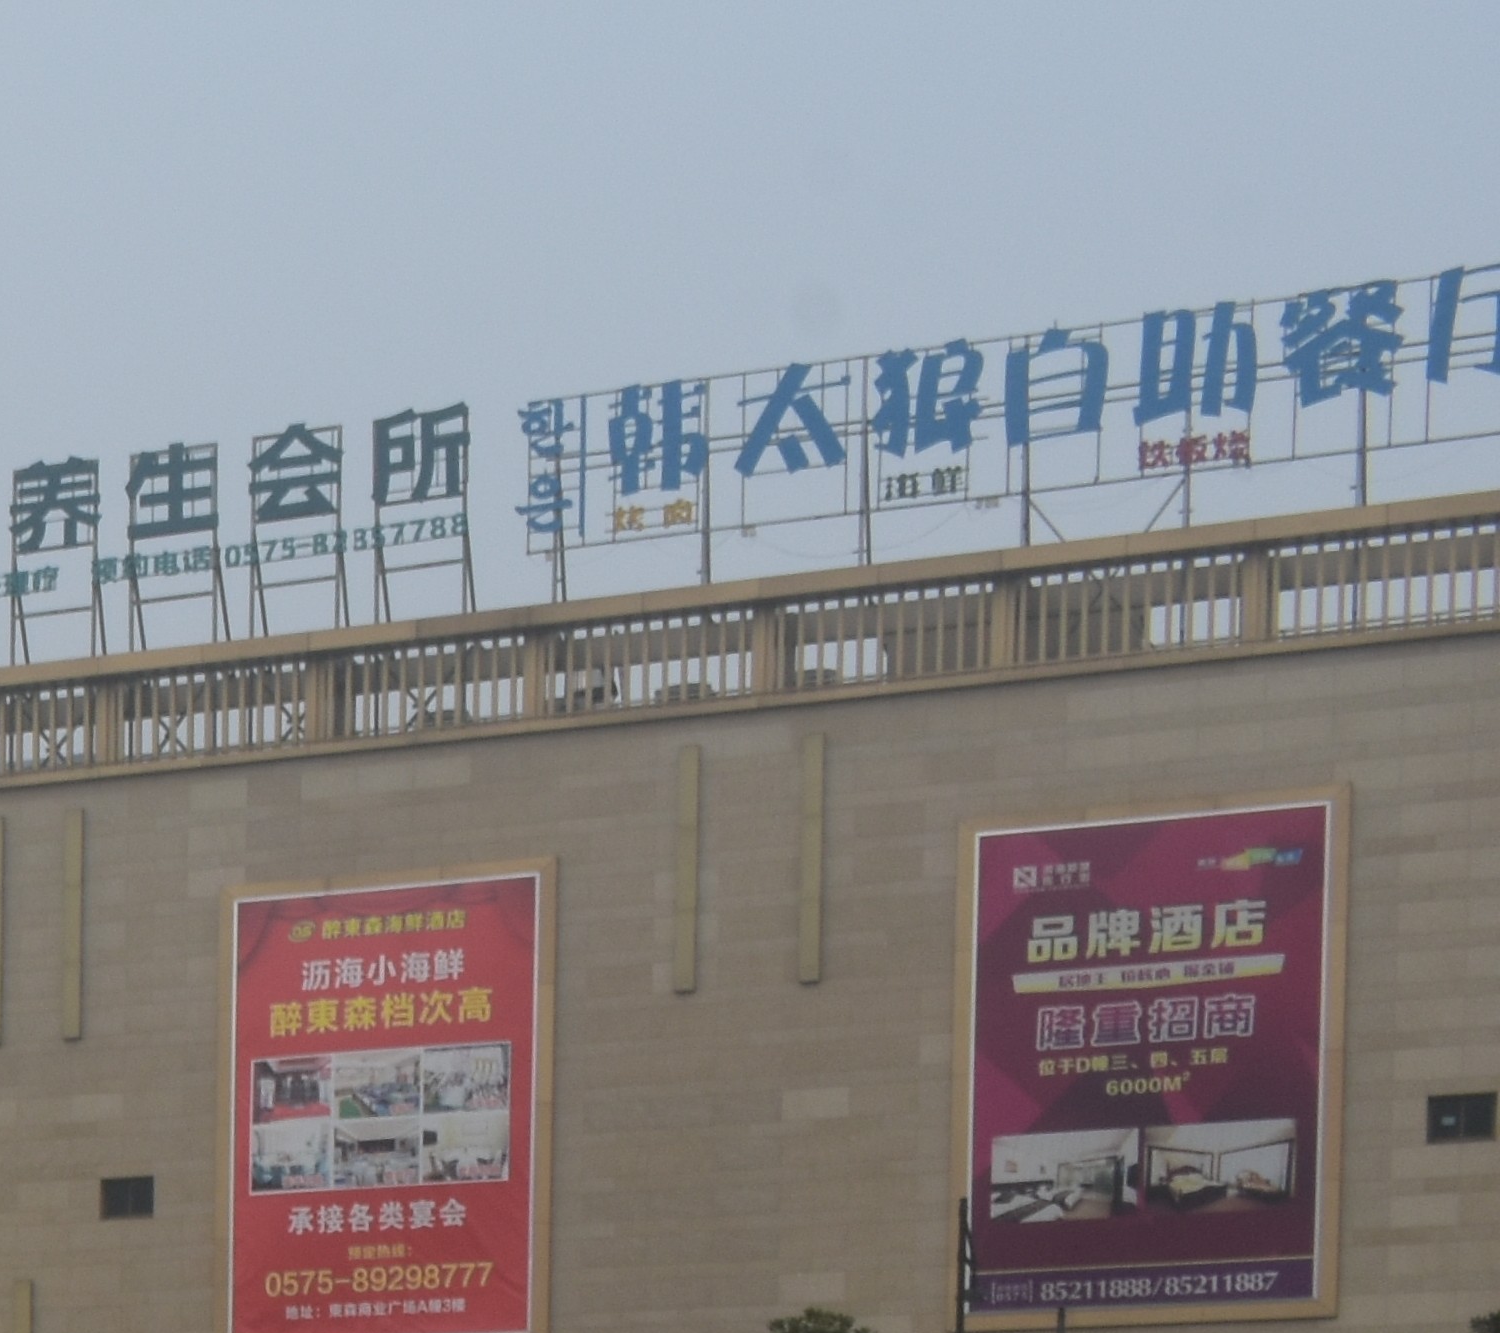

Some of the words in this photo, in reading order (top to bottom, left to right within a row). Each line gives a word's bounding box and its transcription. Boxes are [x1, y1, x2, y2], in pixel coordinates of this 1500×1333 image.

[1027, 900, 1268, 963] 品牌酒店
[302, 947, 466, 991] 沥海小海鲜
[270, 986, 493, 1038] 醉東森档次高
[1035, 992, 1256, 1052] 隆重招商
[288, 1198, 467, 1235] 承接各类宴会
[265, 1261, 494, 1299] 0575-89298777
[1040, 1271, 1280, 1302] 85211888/85211887
